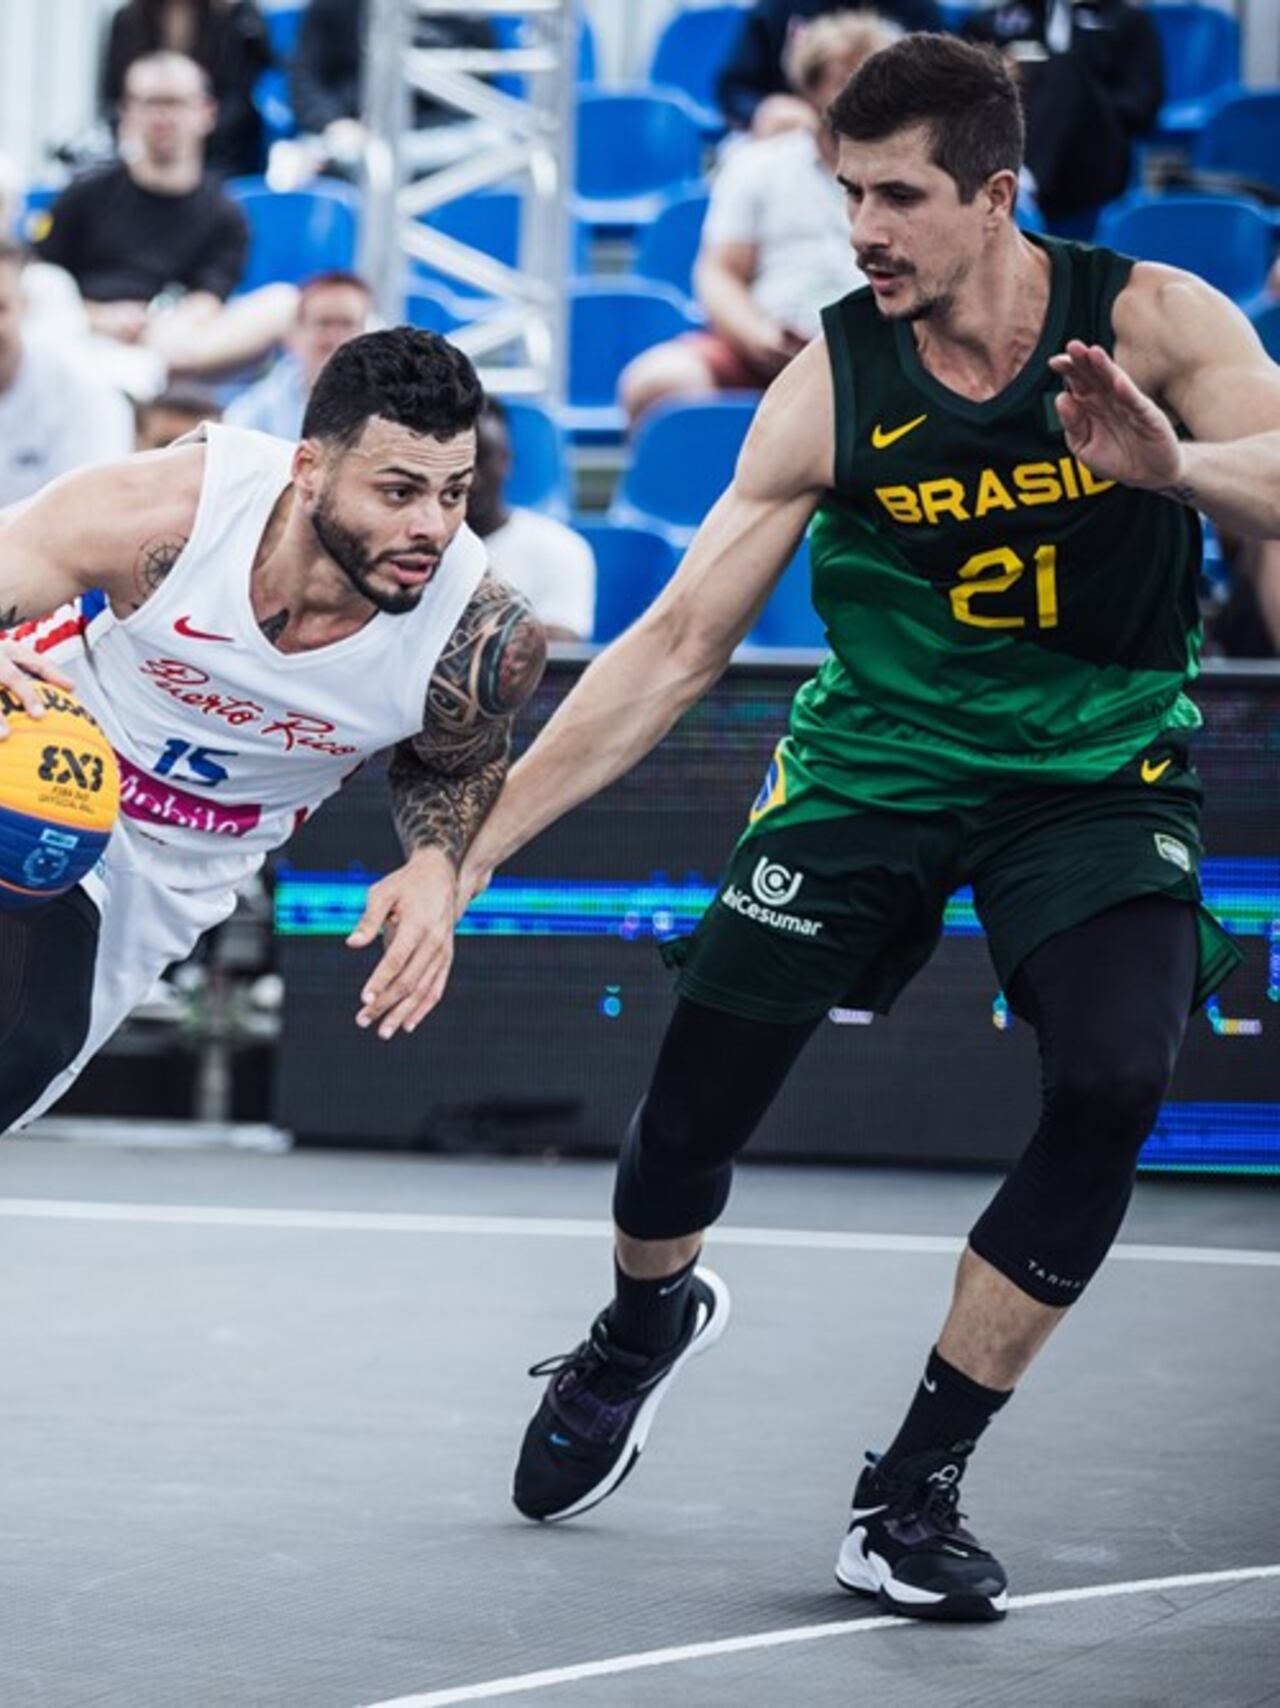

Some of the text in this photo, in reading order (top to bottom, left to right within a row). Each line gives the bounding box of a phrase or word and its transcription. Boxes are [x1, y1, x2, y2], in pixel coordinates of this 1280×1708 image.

[874, 456, 1117, 525] BRASIL
[949, 544, 1058, 629] 21
[139, 657, 264, 726] Puerto
[261, 710, 358, 757] Rico
[153, 736, 239, 788] 15
